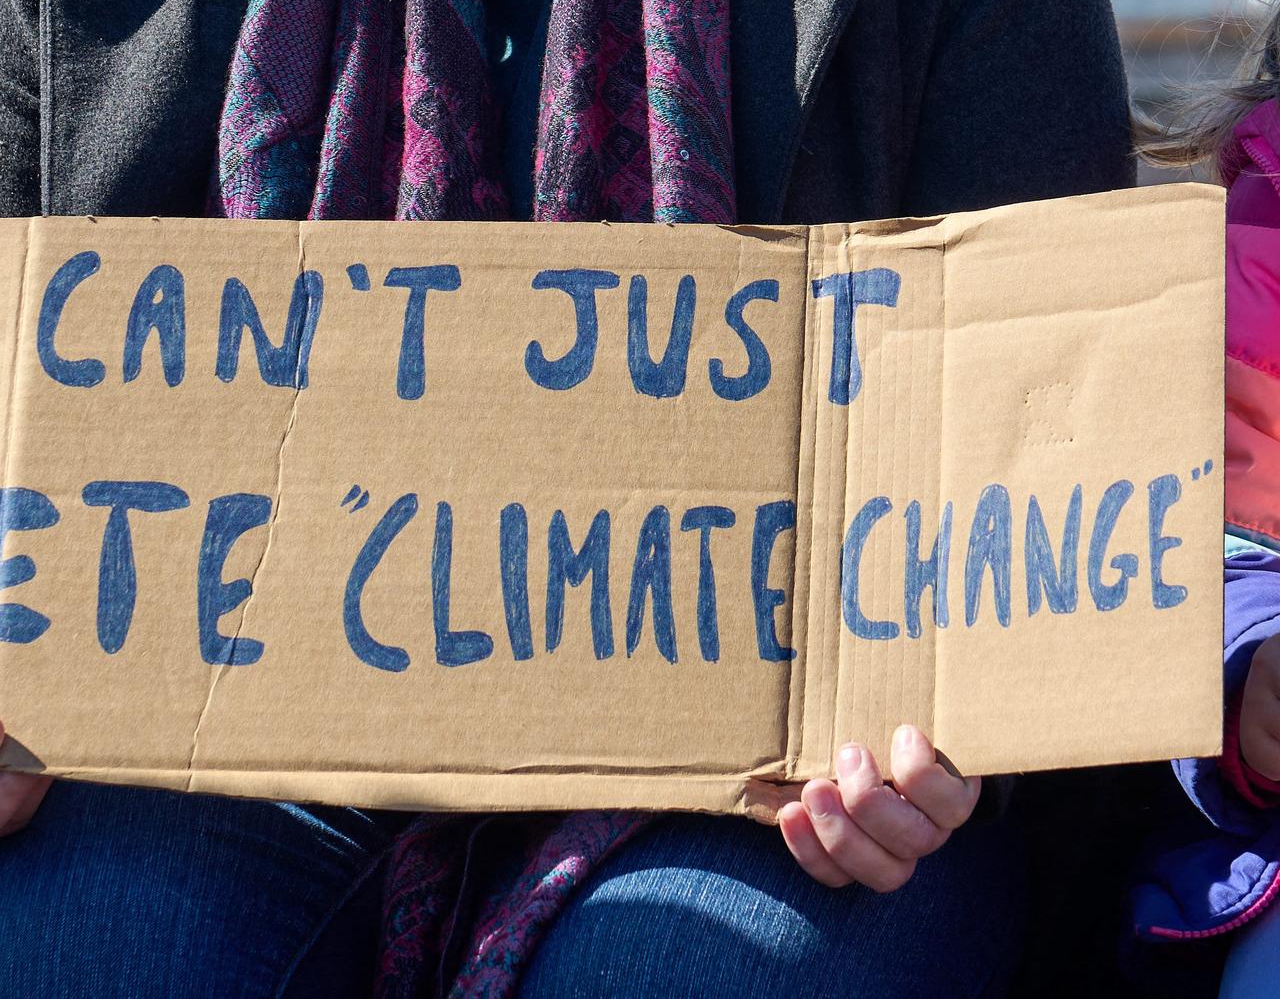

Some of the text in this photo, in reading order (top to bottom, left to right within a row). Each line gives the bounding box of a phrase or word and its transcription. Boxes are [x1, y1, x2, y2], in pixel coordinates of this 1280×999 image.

[37, 252, 460, 399] CAN'T
[525, 269, 900, 405] JUST
[342, 486, 796, 672] "CLIMATE
[841, 461, 1212, 639] CHANGE"
